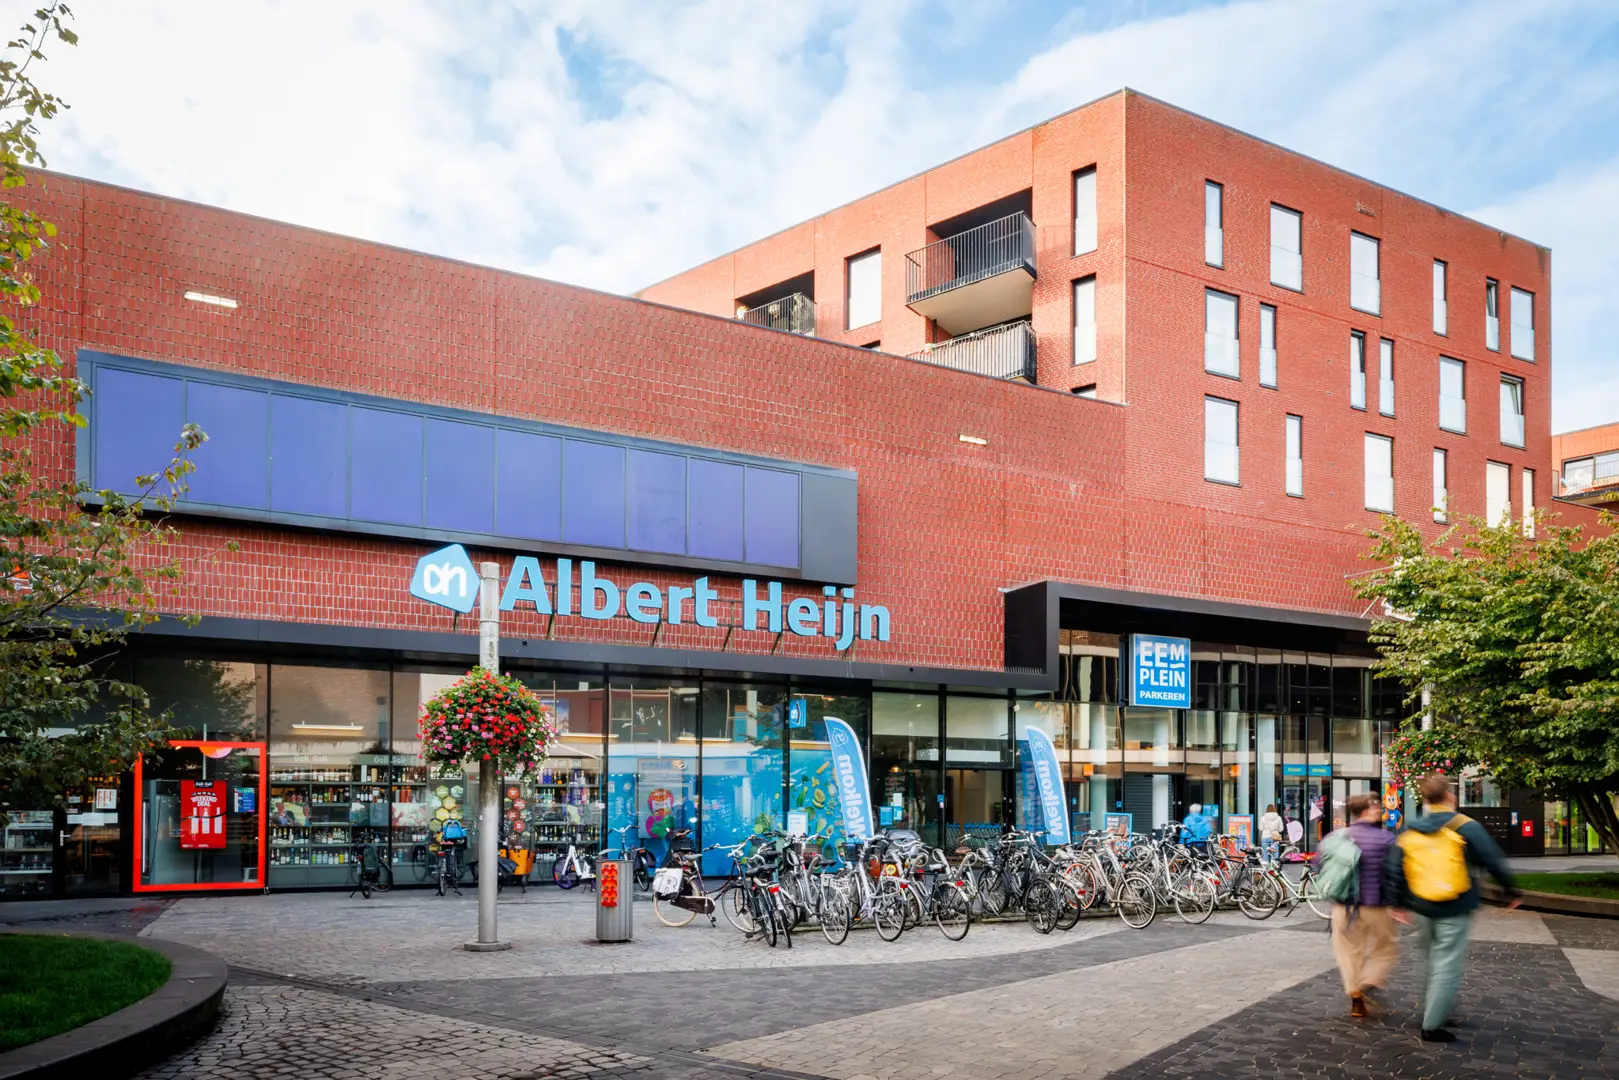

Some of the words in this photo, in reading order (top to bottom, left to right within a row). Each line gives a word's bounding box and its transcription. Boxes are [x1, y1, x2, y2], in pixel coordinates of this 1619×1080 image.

[500, 555, 718, 627] Albert
[743, 579, 891, 650] Heijn
[1139, 640, 1185, 668] EEM
[1139, 668, 1186, 688] PLEIN
[1139, 690, 1186, 701] PARKEREN
[373, 756, 388, 764] Gall
[191, 795, 217, 803] WEEKEND
